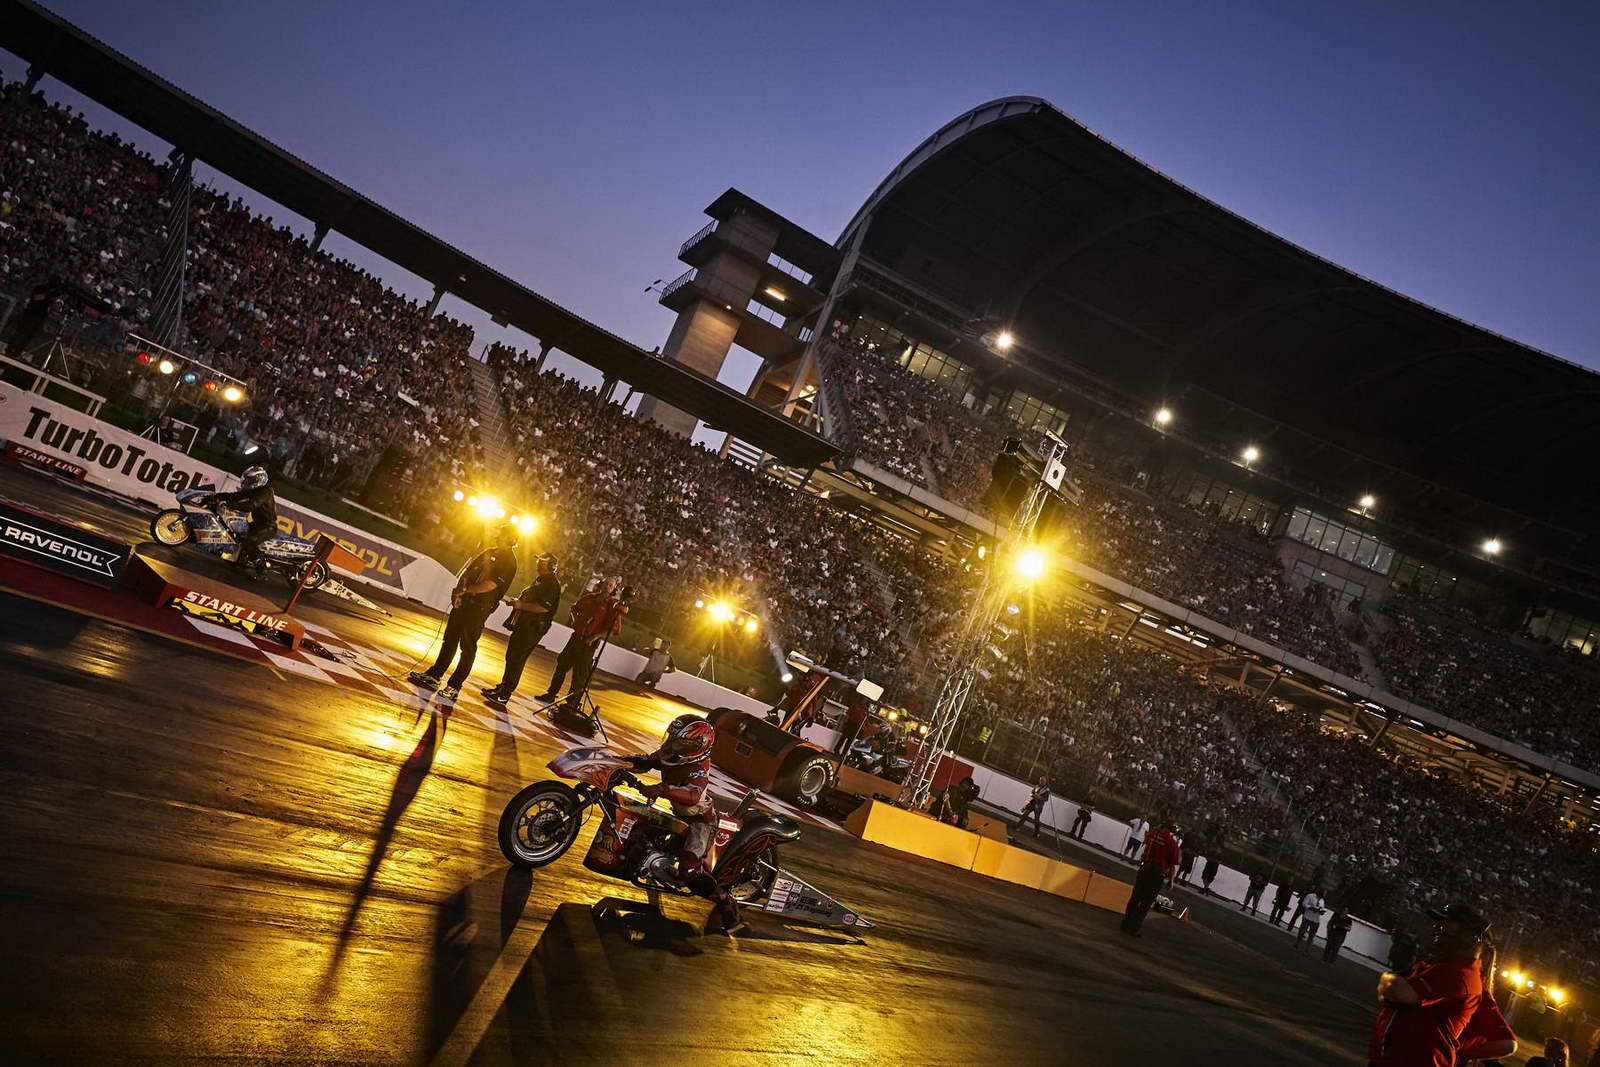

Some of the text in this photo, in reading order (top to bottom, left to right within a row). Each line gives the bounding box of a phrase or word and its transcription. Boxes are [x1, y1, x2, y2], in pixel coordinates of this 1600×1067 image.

[15, 447, 82, 475] START LINE
[5, 526, 103, 567] RAVENOL
[184, 591, 288, 631] START LINE
